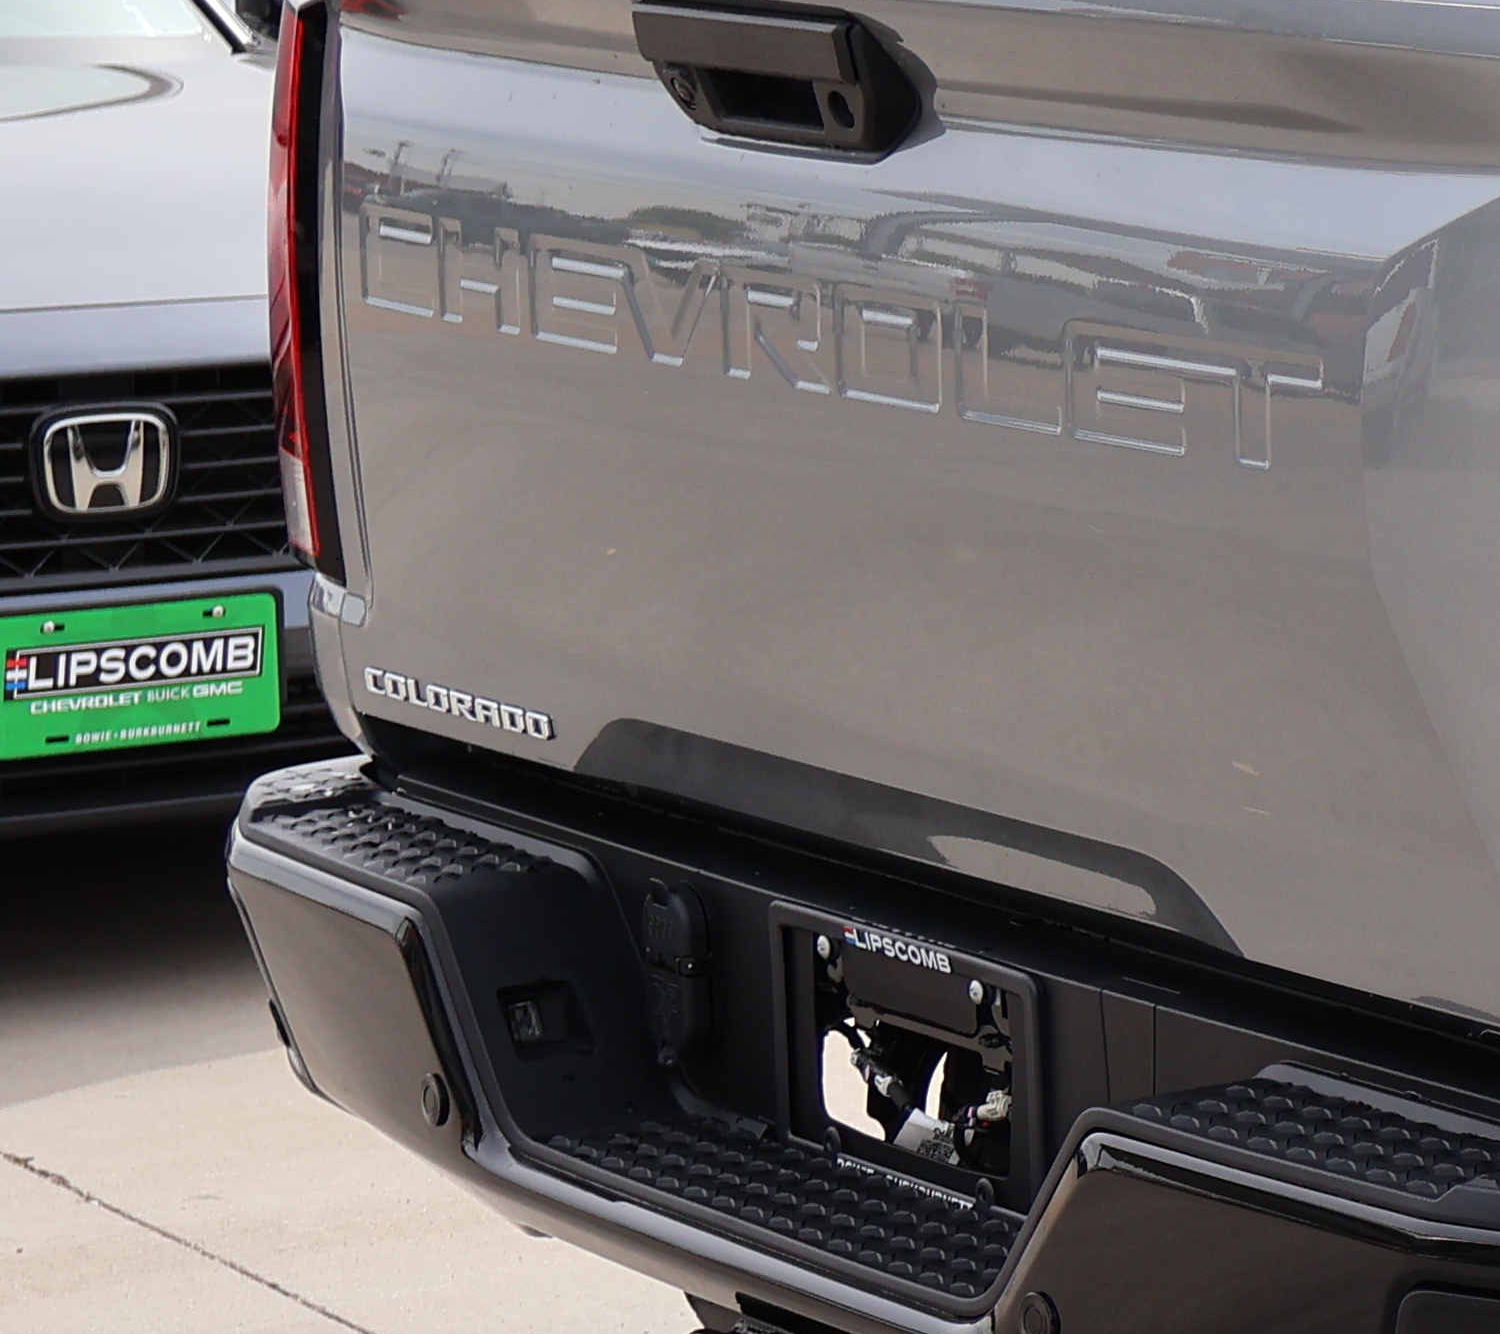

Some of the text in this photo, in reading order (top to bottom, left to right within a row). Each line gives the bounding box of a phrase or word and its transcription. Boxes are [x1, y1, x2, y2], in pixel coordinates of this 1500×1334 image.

[360, 193, 1322, 469] CHEVROLET
[28, 635, 256, 692] LIPSCOMB
[30, 681, 243, 715] CHEVROLET BUICK GMC
[364, 667, 553, 741] COLORADO
[853, 929, 951, 974] LIPSCOMB
